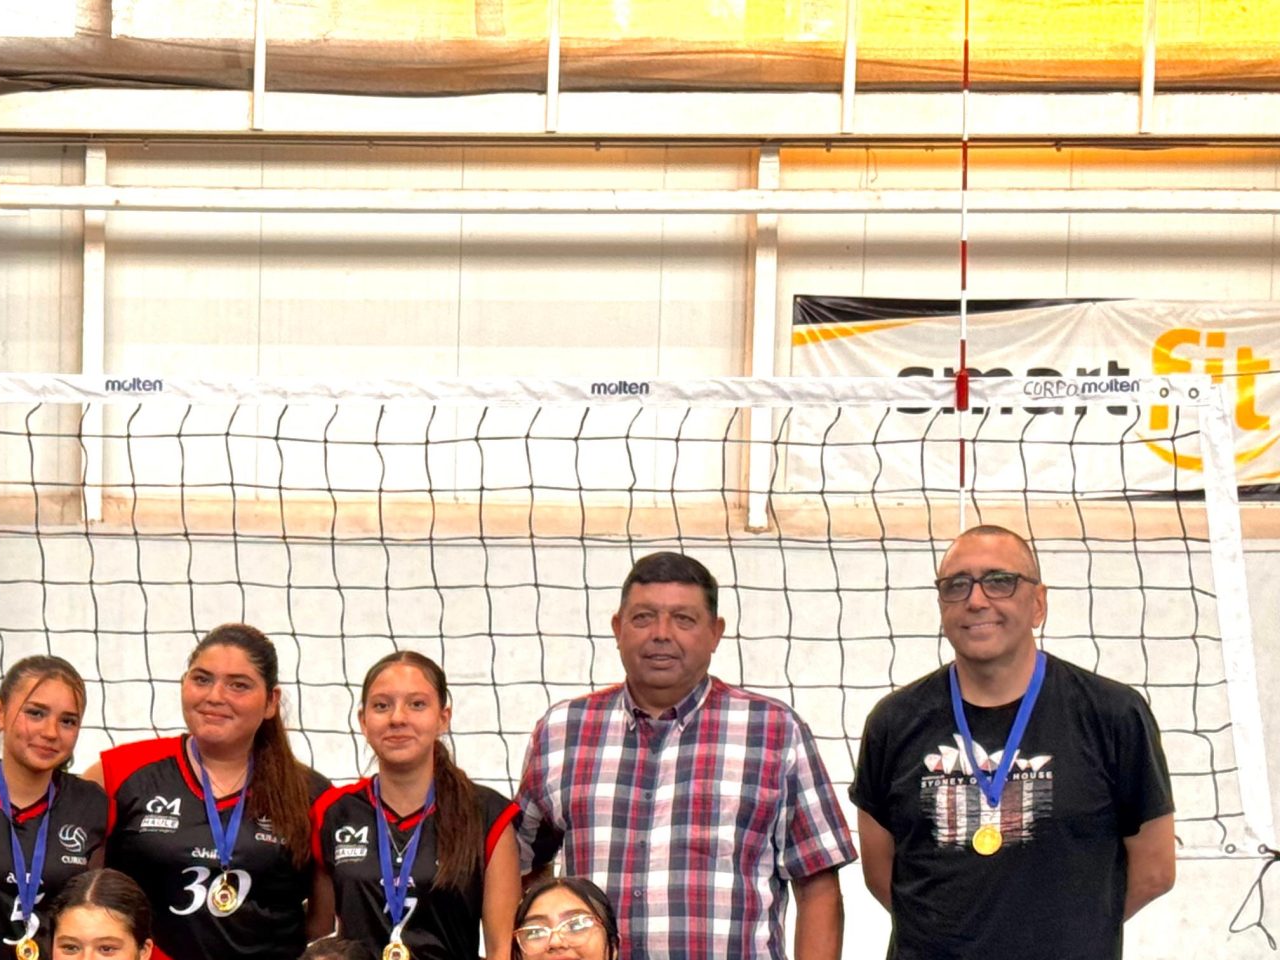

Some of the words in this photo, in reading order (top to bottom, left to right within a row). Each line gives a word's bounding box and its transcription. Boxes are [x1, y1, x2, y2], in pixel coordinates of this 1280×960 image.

[104, 377, 163, 392] molten
[590, 380, 650, 396] molten
[1081, 379, 1139, 394] molten
[1012, 771, 1053, 780] HOUSE
[168, 866, 252, 918] 30
